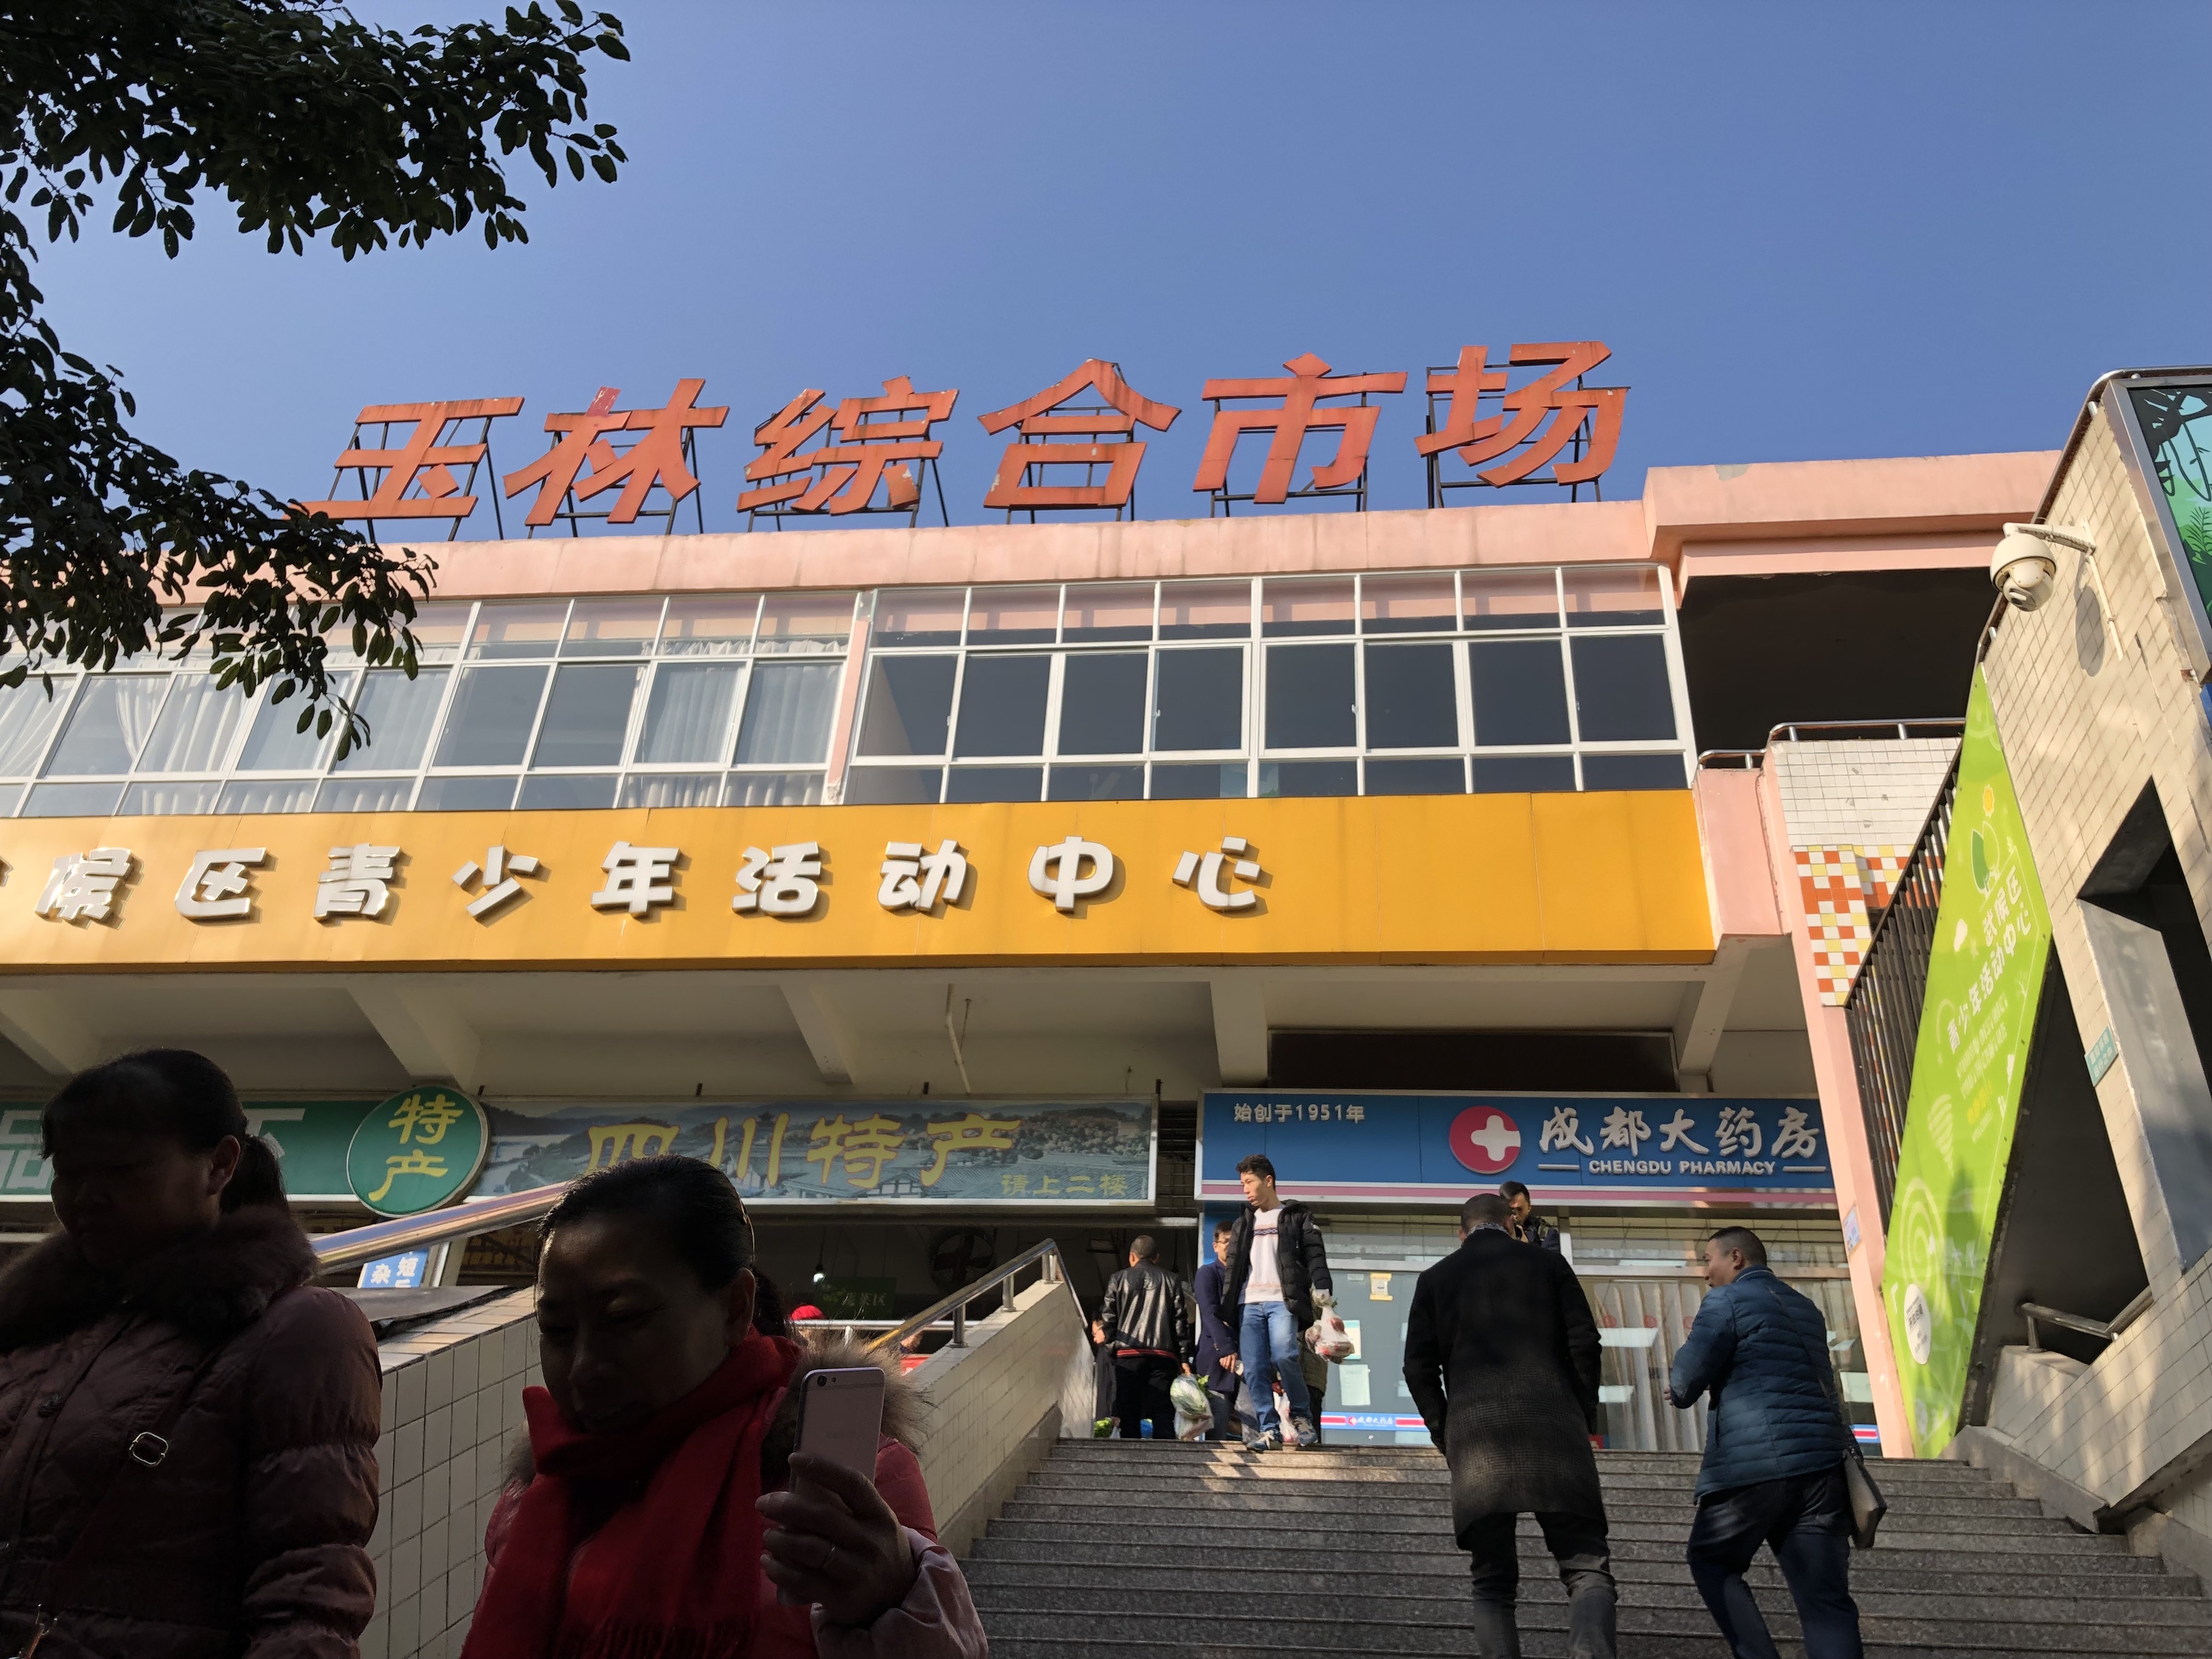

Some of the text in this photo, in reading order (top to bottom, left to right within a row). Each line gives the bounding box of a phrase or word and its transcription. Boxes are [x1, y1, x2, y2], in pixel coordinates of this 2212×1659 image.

[282, 341, 1628, 526] 玉林综合市场
[0, 836, 1262, 924] 侯区青少年活动中心
[1982, 865, 2022, 947] 武侯区
[1947, 901, 2032, 1055] 青少年活动中心
[368, 1093, 464, 1202] 特产
[583, 1111, 1022, 1190] 四川特产
[1234, 1103, 1365, 1124] 始创于1951年
[1538, 1105, 1820, 1158] 成都大药房
[1001, 1173, 1129, 1197] 请上二楼
[1588, 1160, 1775, 1175] CHENGDU PHARMACY
